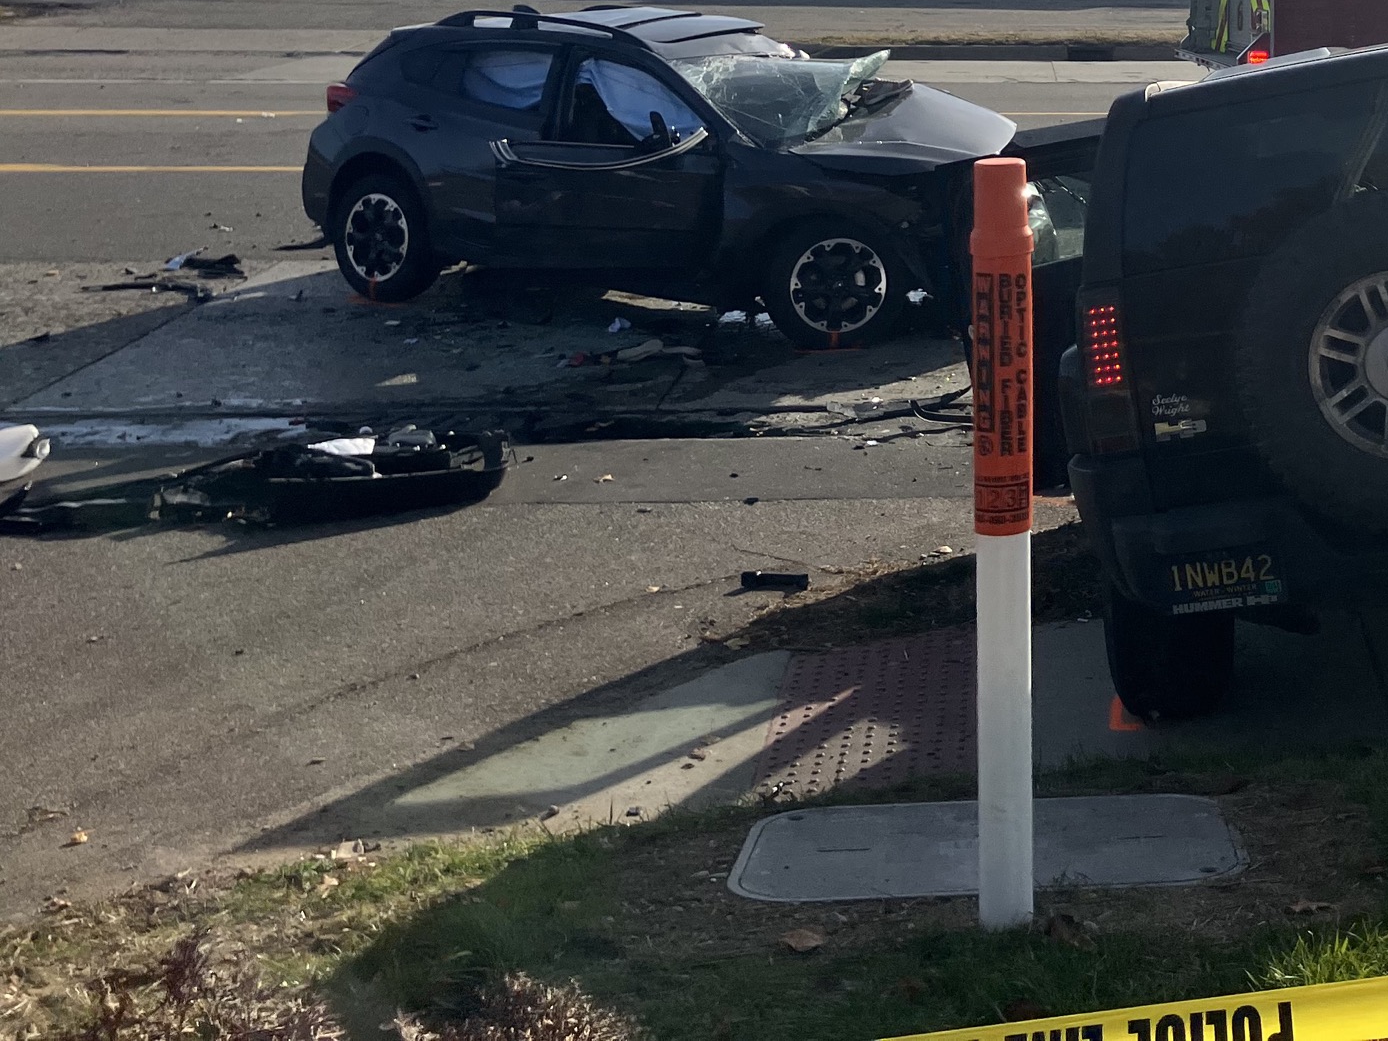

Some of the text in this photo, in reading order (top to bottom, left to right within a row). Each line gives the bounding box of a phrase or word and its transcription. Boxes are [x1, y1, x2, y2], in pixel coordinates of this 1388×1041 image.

[976, 274, 994, 432] WARNING
[999, 273, 1014, 457] BURIED FIBER
[1015, 273, 1028, 454] OPTIC CABLE
[1170, 554, 1276, 593] 1NWB42
[1171, 597, 1244, 615] HUMMER
